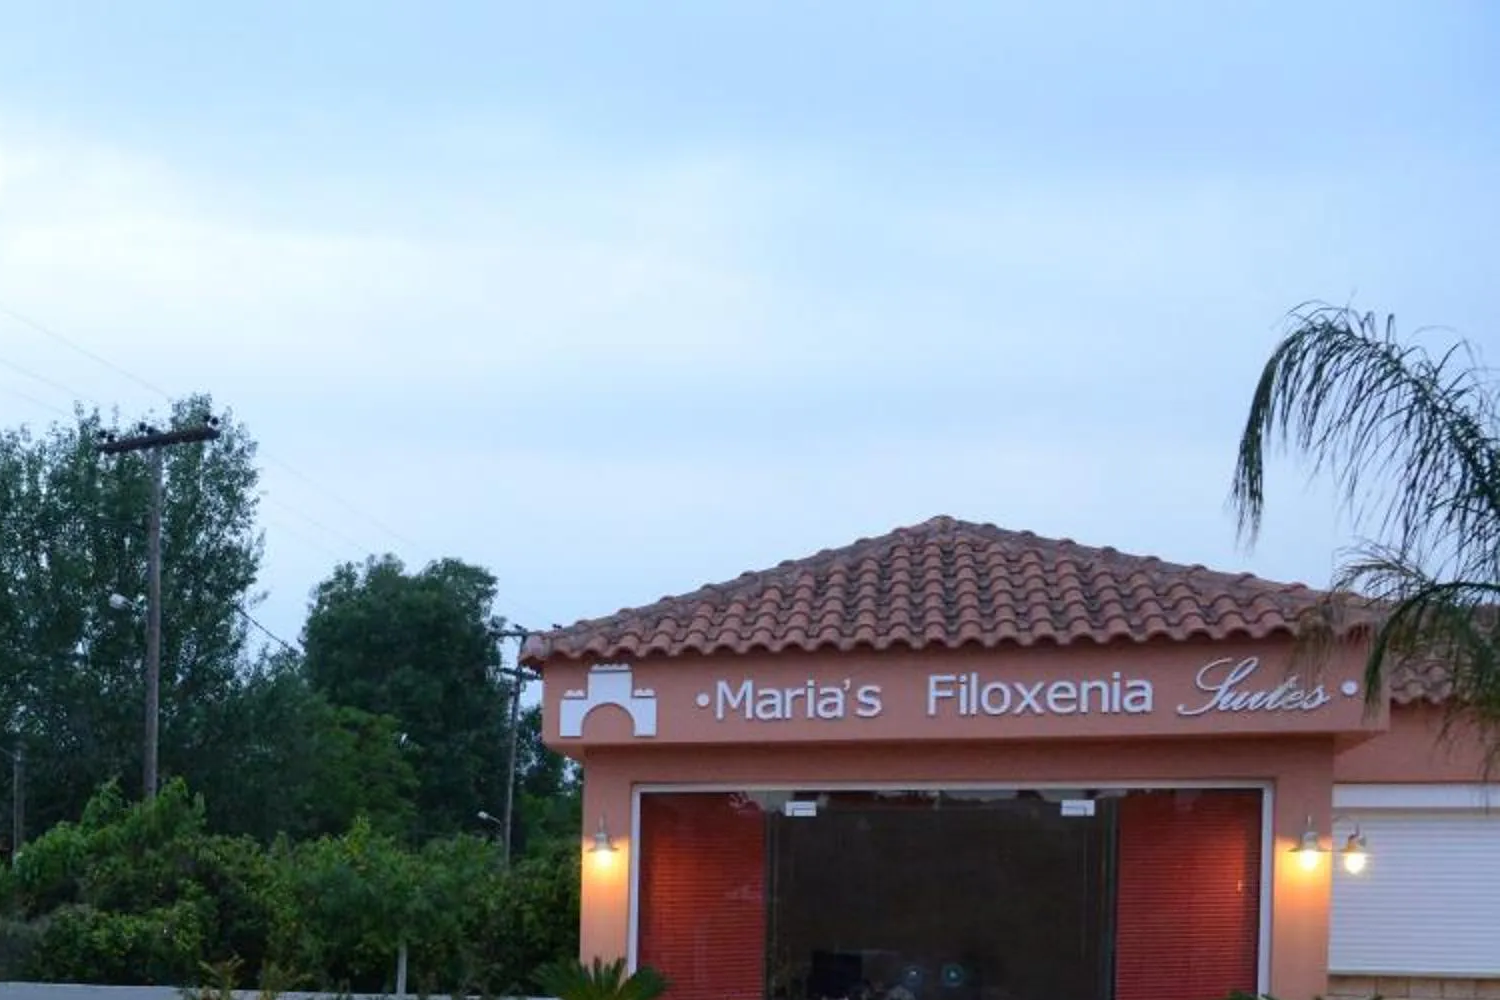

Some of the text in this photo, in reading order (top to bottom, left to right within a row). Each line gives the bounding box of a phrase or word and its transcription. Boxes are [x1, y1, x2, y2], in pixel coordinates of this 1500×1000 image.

[715, 656, 1331, 720] Maria's Filoxenia Suites
